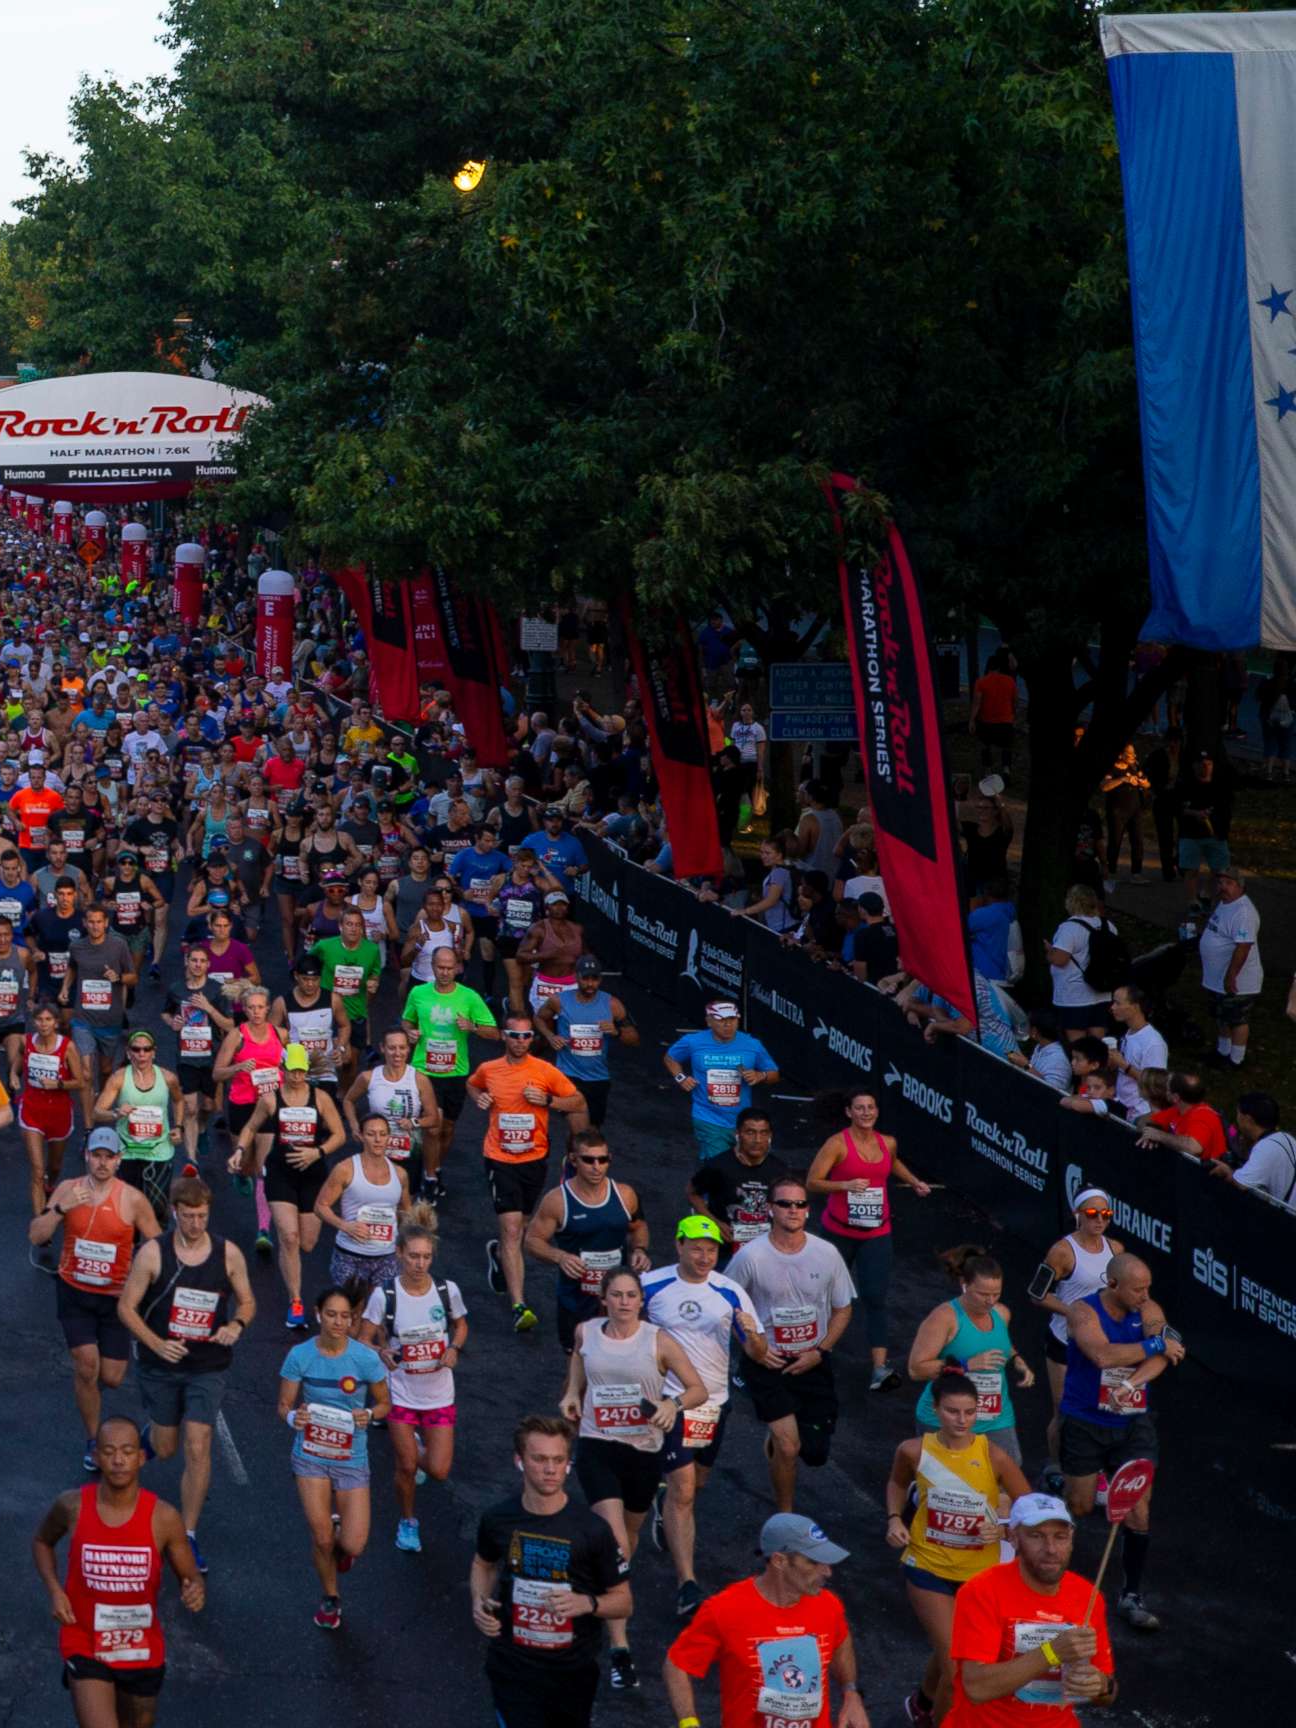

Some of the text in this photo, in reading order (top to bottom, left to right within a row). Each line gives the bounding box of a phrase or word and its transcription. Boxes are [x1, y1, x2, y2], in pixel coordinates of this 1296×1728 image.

[50, 446, 190, 458] HALF MARATHON 7.6K
[4, 465, 238, 480] Humana PHILADELPHIA Humana
[859, 568, 891, 777] MARATHON SERIES
[776, 989, 805, 1028] ULTRA
[573, 1039, 600, 1048] 2033
[828, 1025, 873, 1073] BROOKS
[429, 1053, 452, 1062] 2011
[712, 1085, 737, 1094] 2818
[901, 1072, 953, 1125] BROOKS
[504, 1130, 531, 1140] 2179
[970, 1136, 1045, 1192] MARATHON SERIES
[77, 1258, 111, 1274] 2250
[1241, 1276, 1296, 1321] SCIENCE
[1242, 1293, 1256, 1315] IN
[176, 1308, 209, 1323] 2377
[781, 1324, 814, 1338] 2122
[407, 1343, 440, 1357] 2314
[599, 1407, 641, 1421] 2470
[310, 1426, 347, 1444] 2345
[1115, 1475, 1147, 1493] 1:40
[935, 1511, 979, 1531] 1787
[85, 1563, 148, 1576] FITNESS
[87, 1579, 145, 1592] PASADENA
[101, 1629, 144, 1647] 2379
[768, 1653, 794, 1676] PACE
